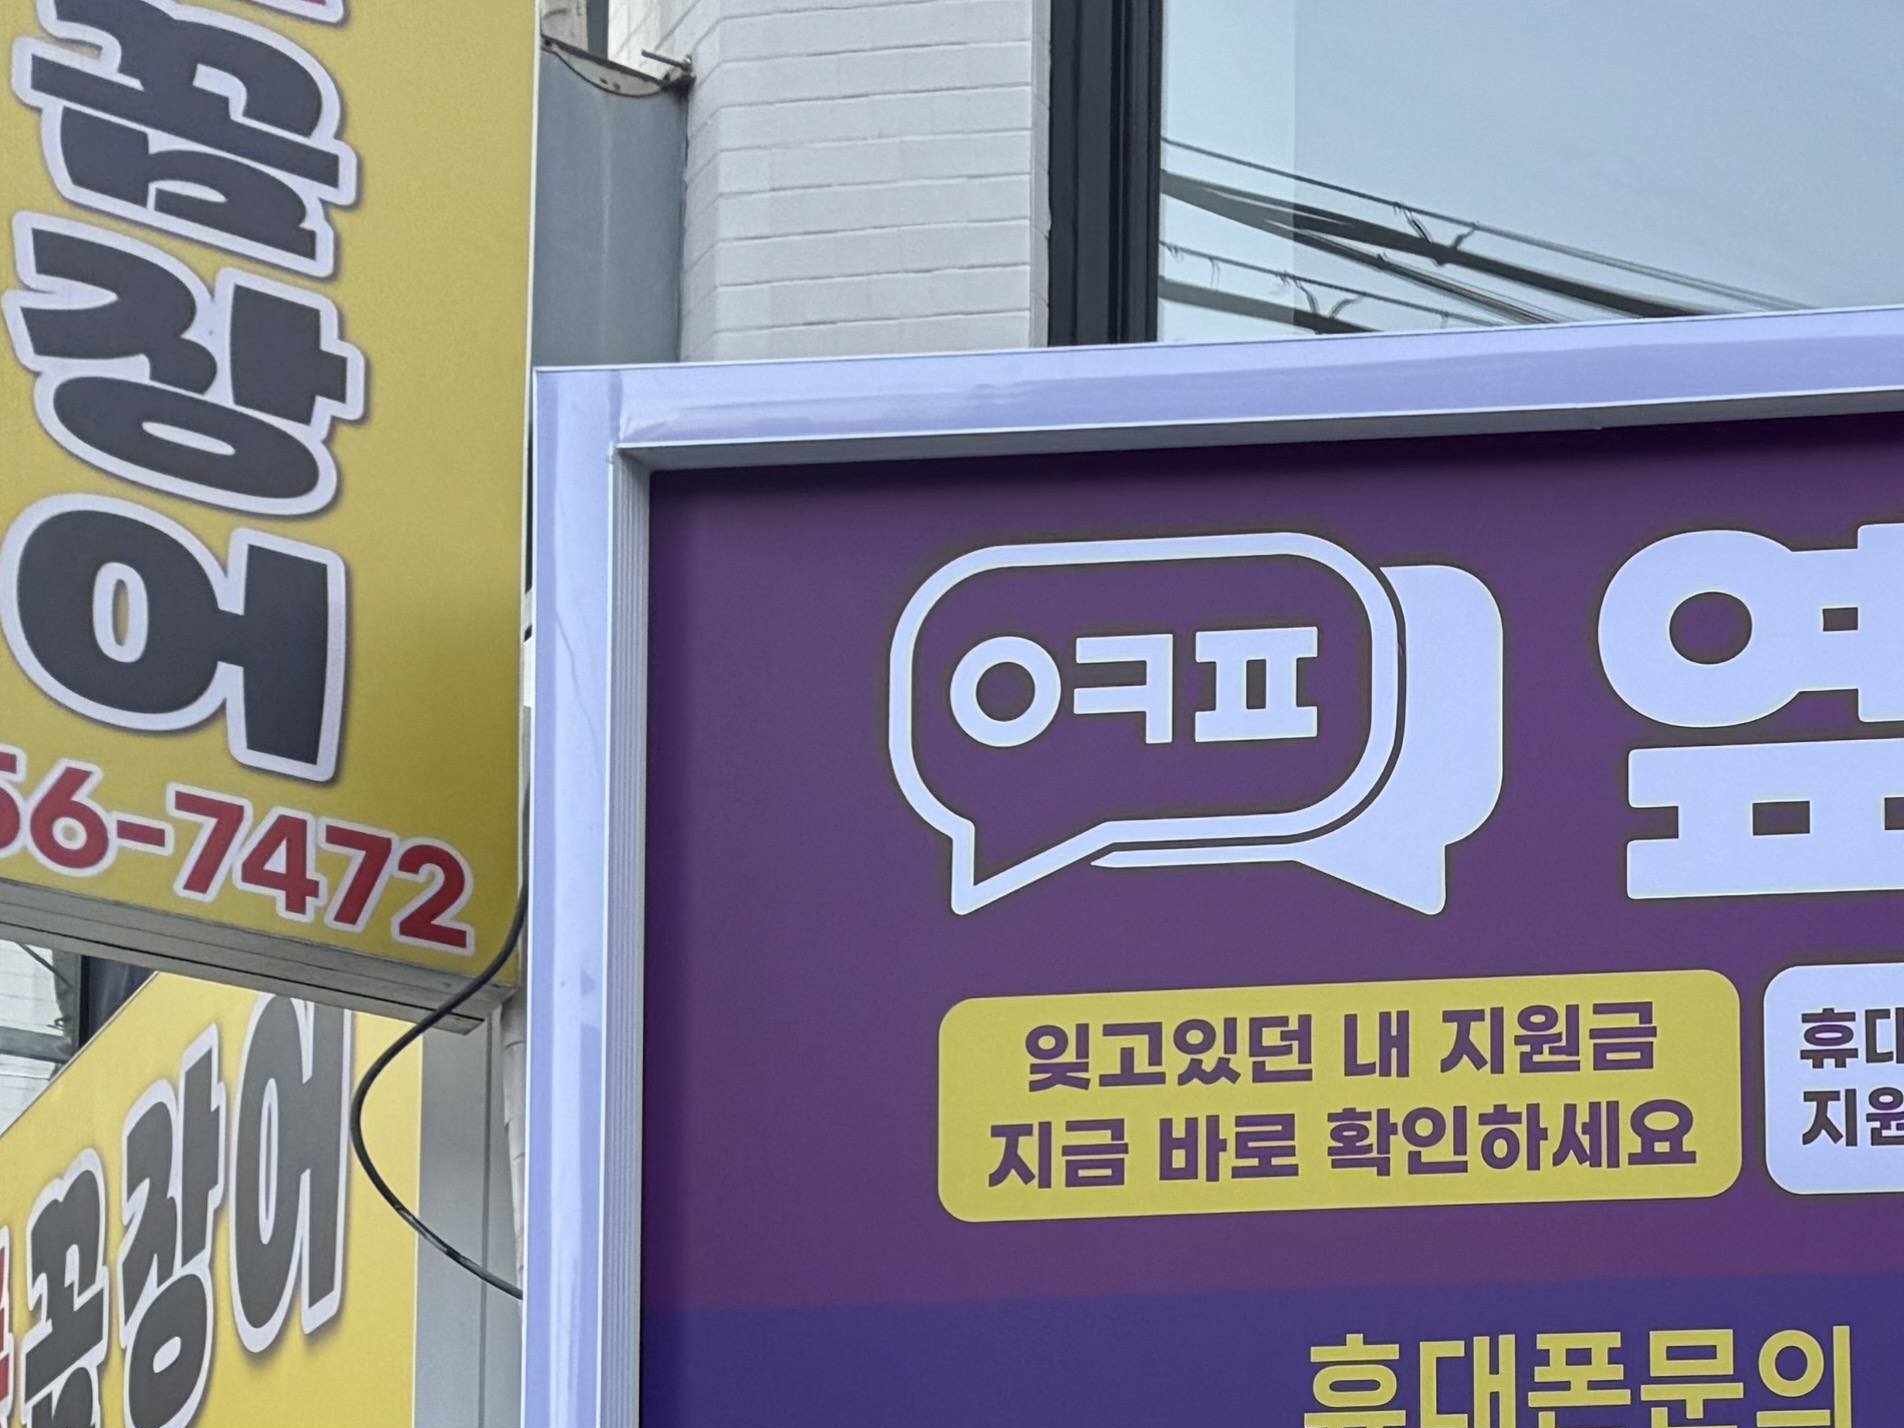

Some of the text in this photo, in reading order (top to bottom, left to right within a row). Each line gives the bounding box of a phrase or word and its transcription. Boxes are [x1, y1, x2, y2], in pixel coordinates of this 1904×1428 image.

[1024, 1001, 1658, 1092] 잊고있던 내 지원금
[988, 1098, 1697, 1189] 지금 바로 확인하세요
